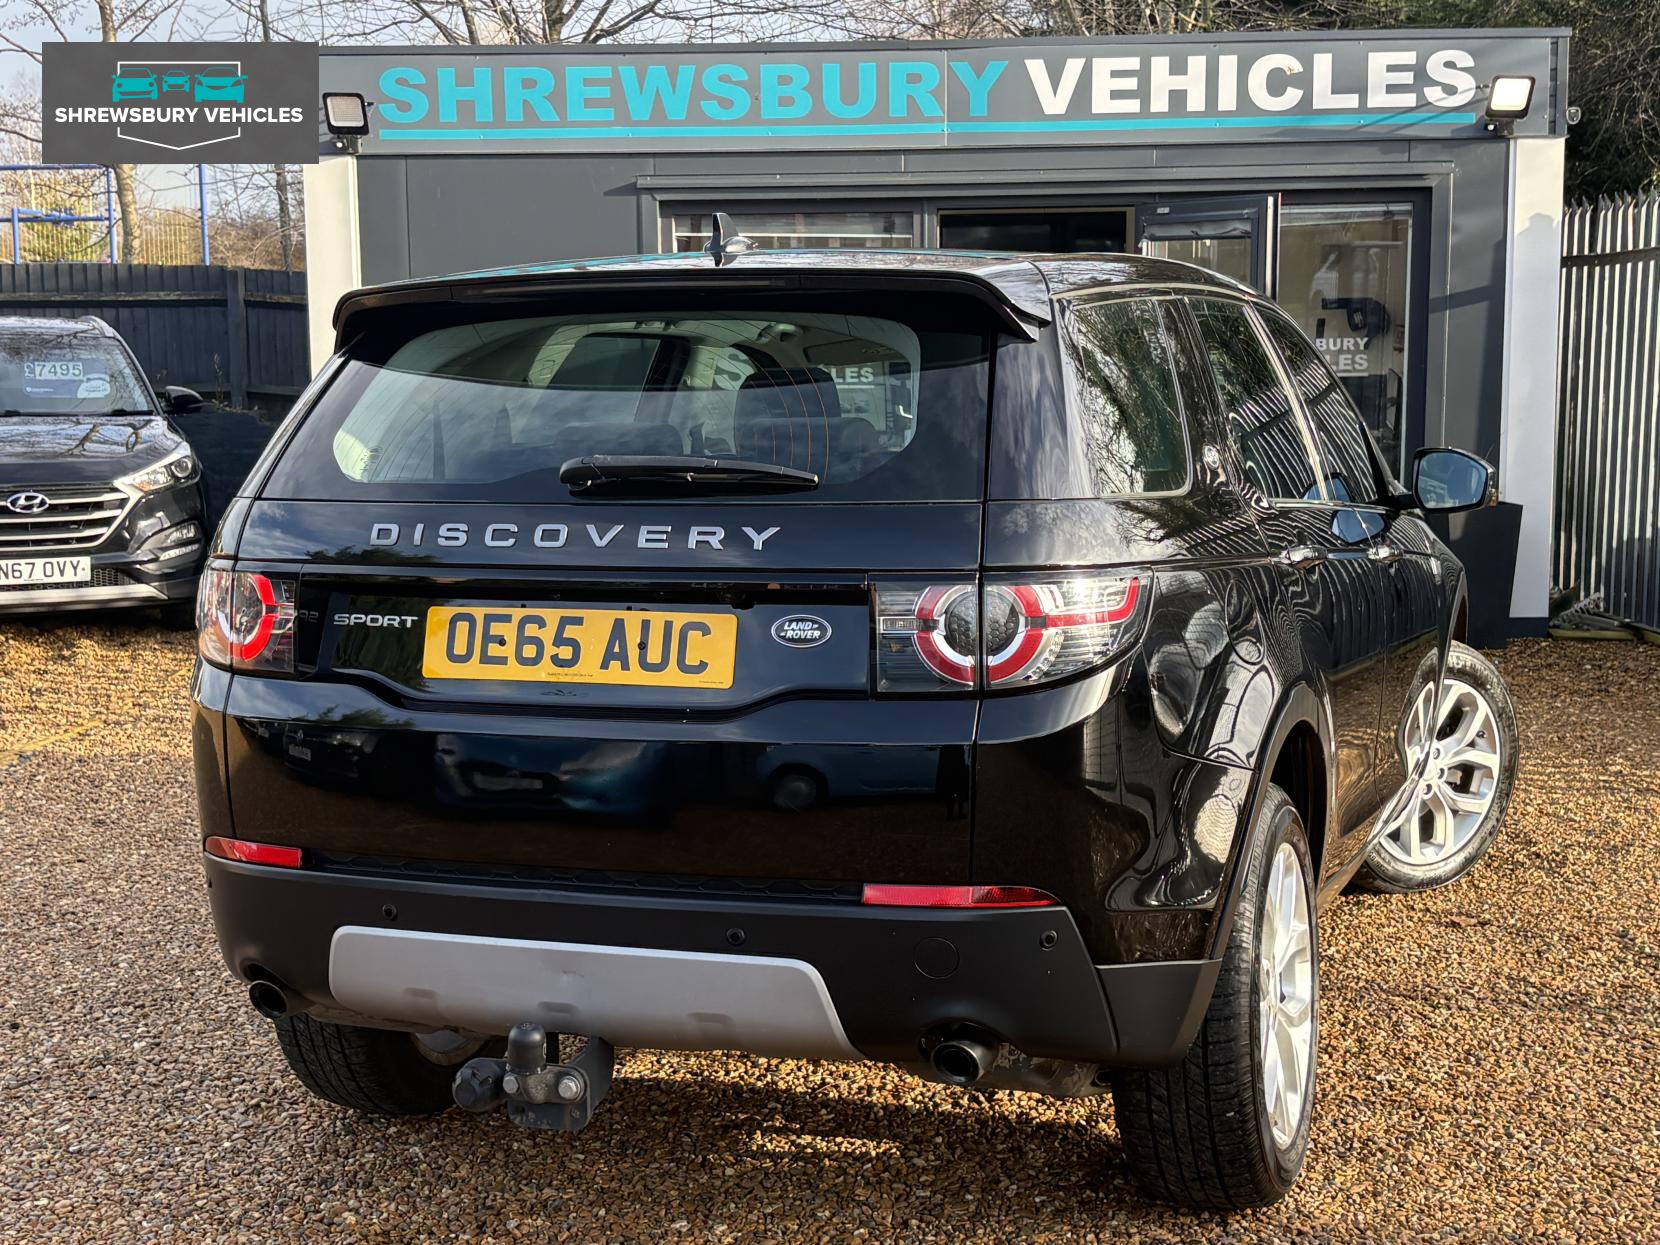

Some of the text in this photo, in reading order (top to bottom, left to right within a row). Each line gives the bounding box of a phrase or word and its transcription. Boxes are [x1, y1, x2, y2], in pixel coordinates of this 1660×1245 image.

[377, 49, 1477, 123] SHREWSBURY VEHICLES
[370, 522, 782, 551] DISCOVERY
[0, 560, 80, 580] N67 OVY
[333, 613, 419, 629] SPORT
[783, 621, 813, 630] LAND
[445, 612, 713, 675] OE65 AUC
[785, 630, 821, 639] ROVER
